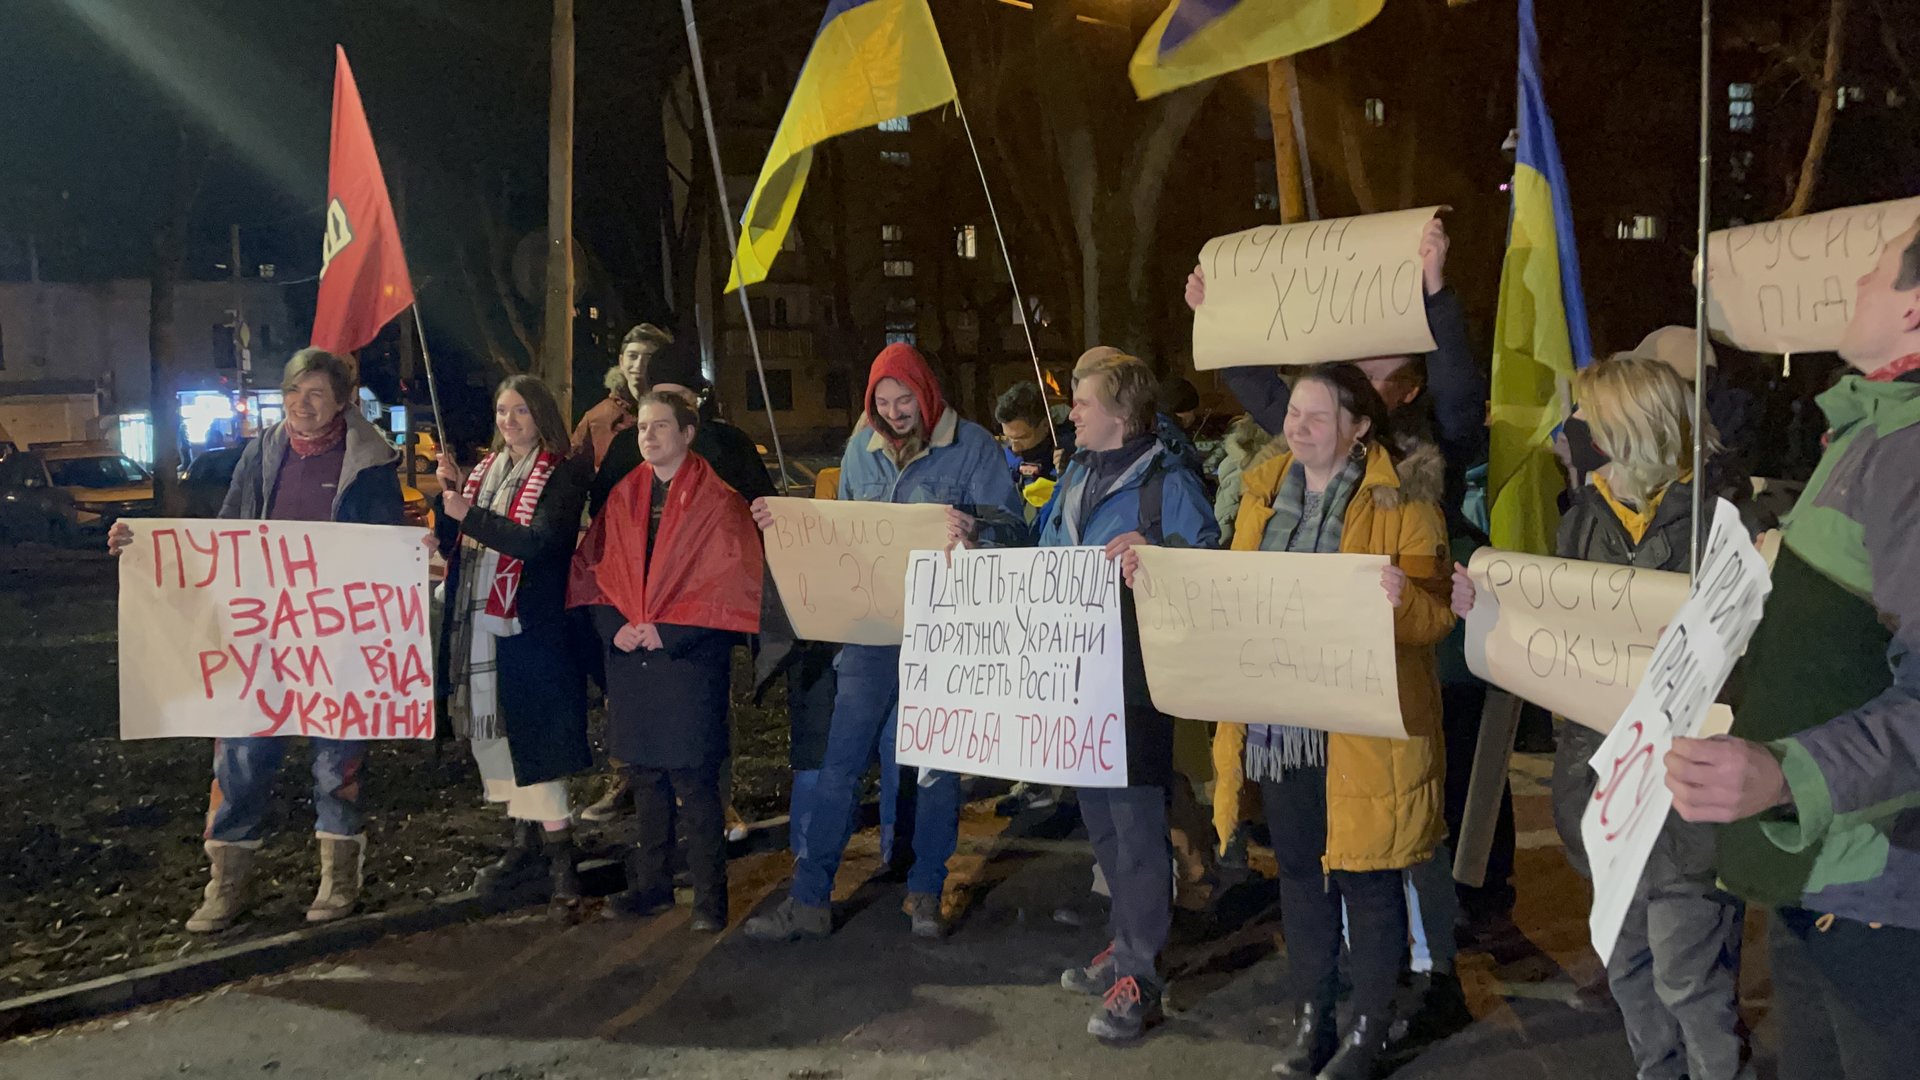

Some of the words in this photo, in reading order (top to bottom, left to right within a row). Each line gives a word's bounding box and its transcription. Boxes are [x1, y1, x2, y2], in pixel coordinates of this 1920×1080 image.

[1266, 252, 1417, 341] ХУЙЛО
[152, 524, 318, 588] ПУТІН
[775, 511, 895, 550] ВІРИМО
[229, 582, 426, 639] ЗАБЕРИ
[911, 552, 1006, 614] ГІДНІСТЬ
[1008, 571, 1027, 605] ТА
[1028, 548, 1118, 614] СВОБОДА
[1142, 574, 1308, 632] УКРАЇНА
[1486, 559, 1642, 633] РОСІЯ
[199, 643, 334, 700] РУКИ
[360, 638, 431, 697] ВІД
[904, 663, 929, 693] ТА
[947, 663, 1012, 697] СМЕРТЬ
[1239, 637, 1385, 697] ЄДИНА
[250, 689, 434, 739] УКРАЇНИ
[899, 705, 1001, 765] БОРОТЬБА
[1015, 712, 1119, 774] ТРИВАЄ
